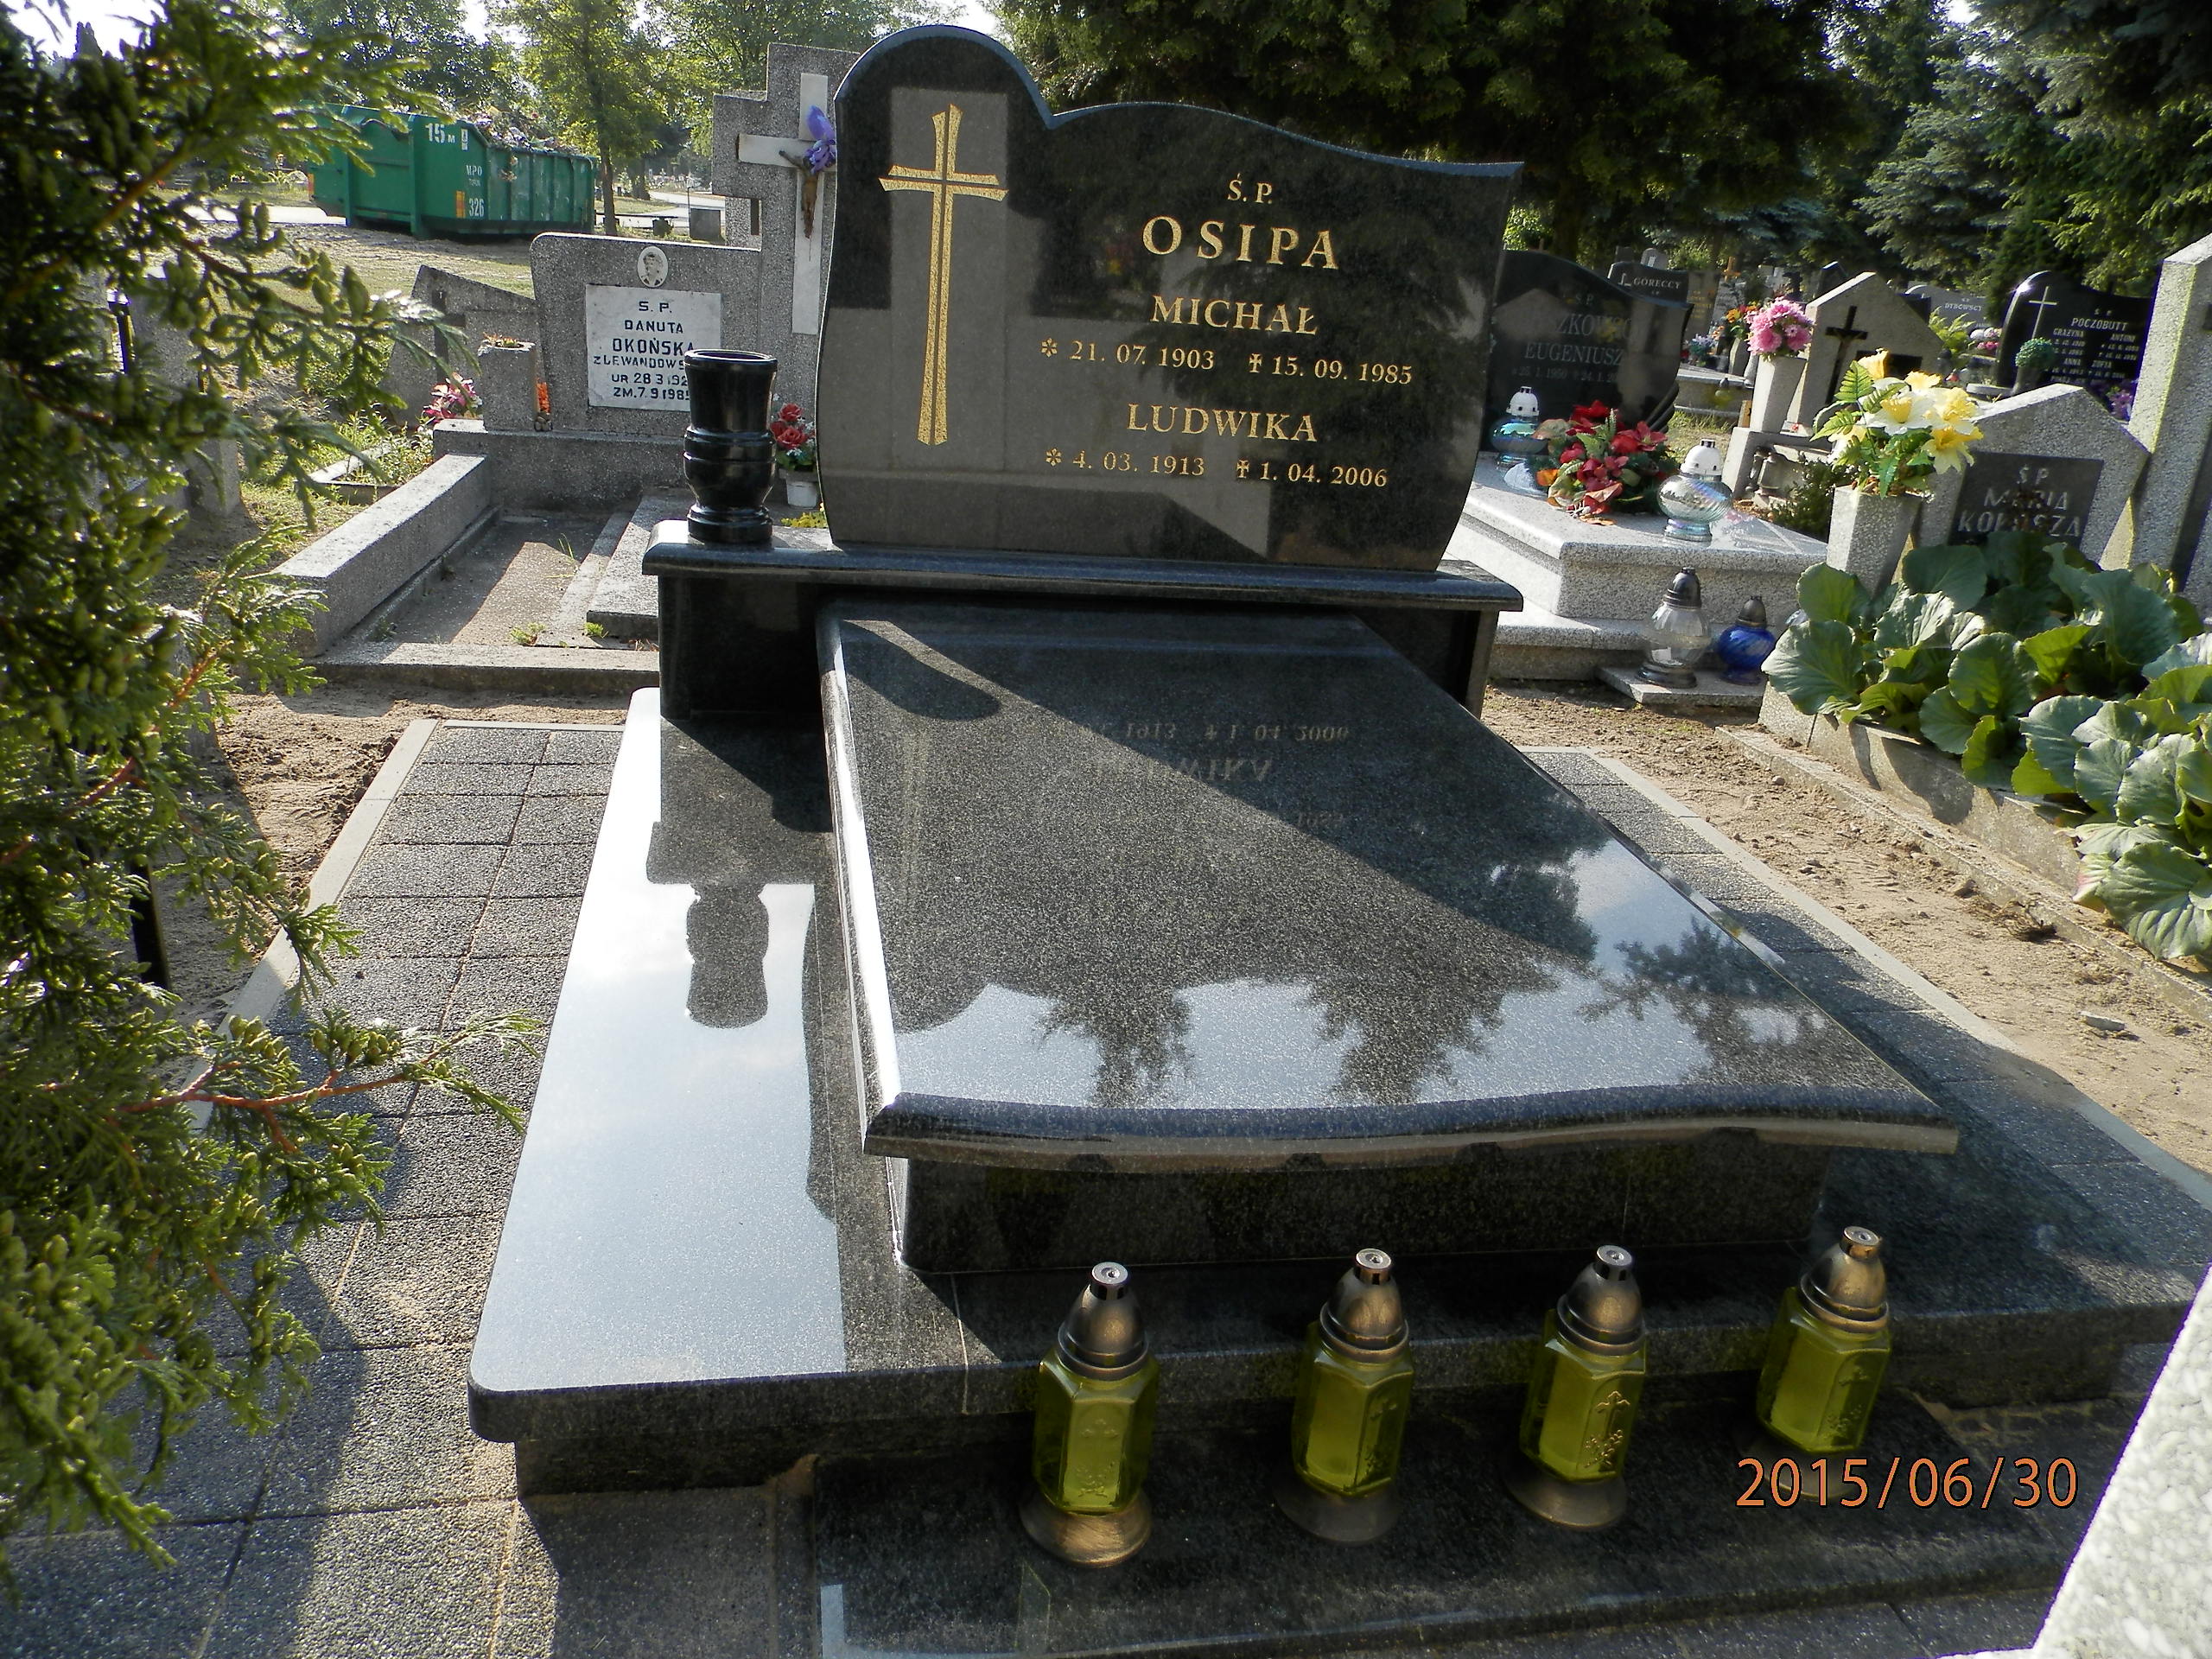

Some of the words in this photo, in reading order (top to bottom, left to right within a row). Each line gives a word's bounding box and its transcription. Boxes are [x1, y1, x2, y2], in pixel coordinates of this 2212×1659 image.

[425, 124, 445, 143] 15
[467, 165, 483, 176] MPO
[1227, 173, 1247, 202] Ś.
[1255, 182, 1273, 205] P.
[468, 198, 484, 218] 326
[1142, 215, 1339, 270] OSIPA
[1150, 295, 1319, 335] MICHAŁ
[2070, 317, 2128, 332] POCZOBUTT
[624, 320, 683, 334] DANUTA
[1069, 340, 1106, 362] 21.
[1116, 344, 1146, 365] 07.
[1158, 347, 1215, 370] 1903
[1272, 356, 1304, 377] 15.
[1314, 359, 1348, 380] 09.
[1358, 363, 1413, 385] 1985
[1524, 342, 1625, 365] EUGENIUSZ
[611, 374, 628, 384] UR
[634, 372, 651, 385] 28
[668, 375, 688, 386] 192
[1127, 403, 1318, 442] LUDWIKA
[1072, 450, 1092, 469] 4.
[1103, 451, 1138, 472] 03.
[1150, 455, 1205, 476] 1913
[1260, 461, 1278, 480] 1.
[1287, 463, 1321, 484] 04.
[1331, 466, 1388, 487] 2006
